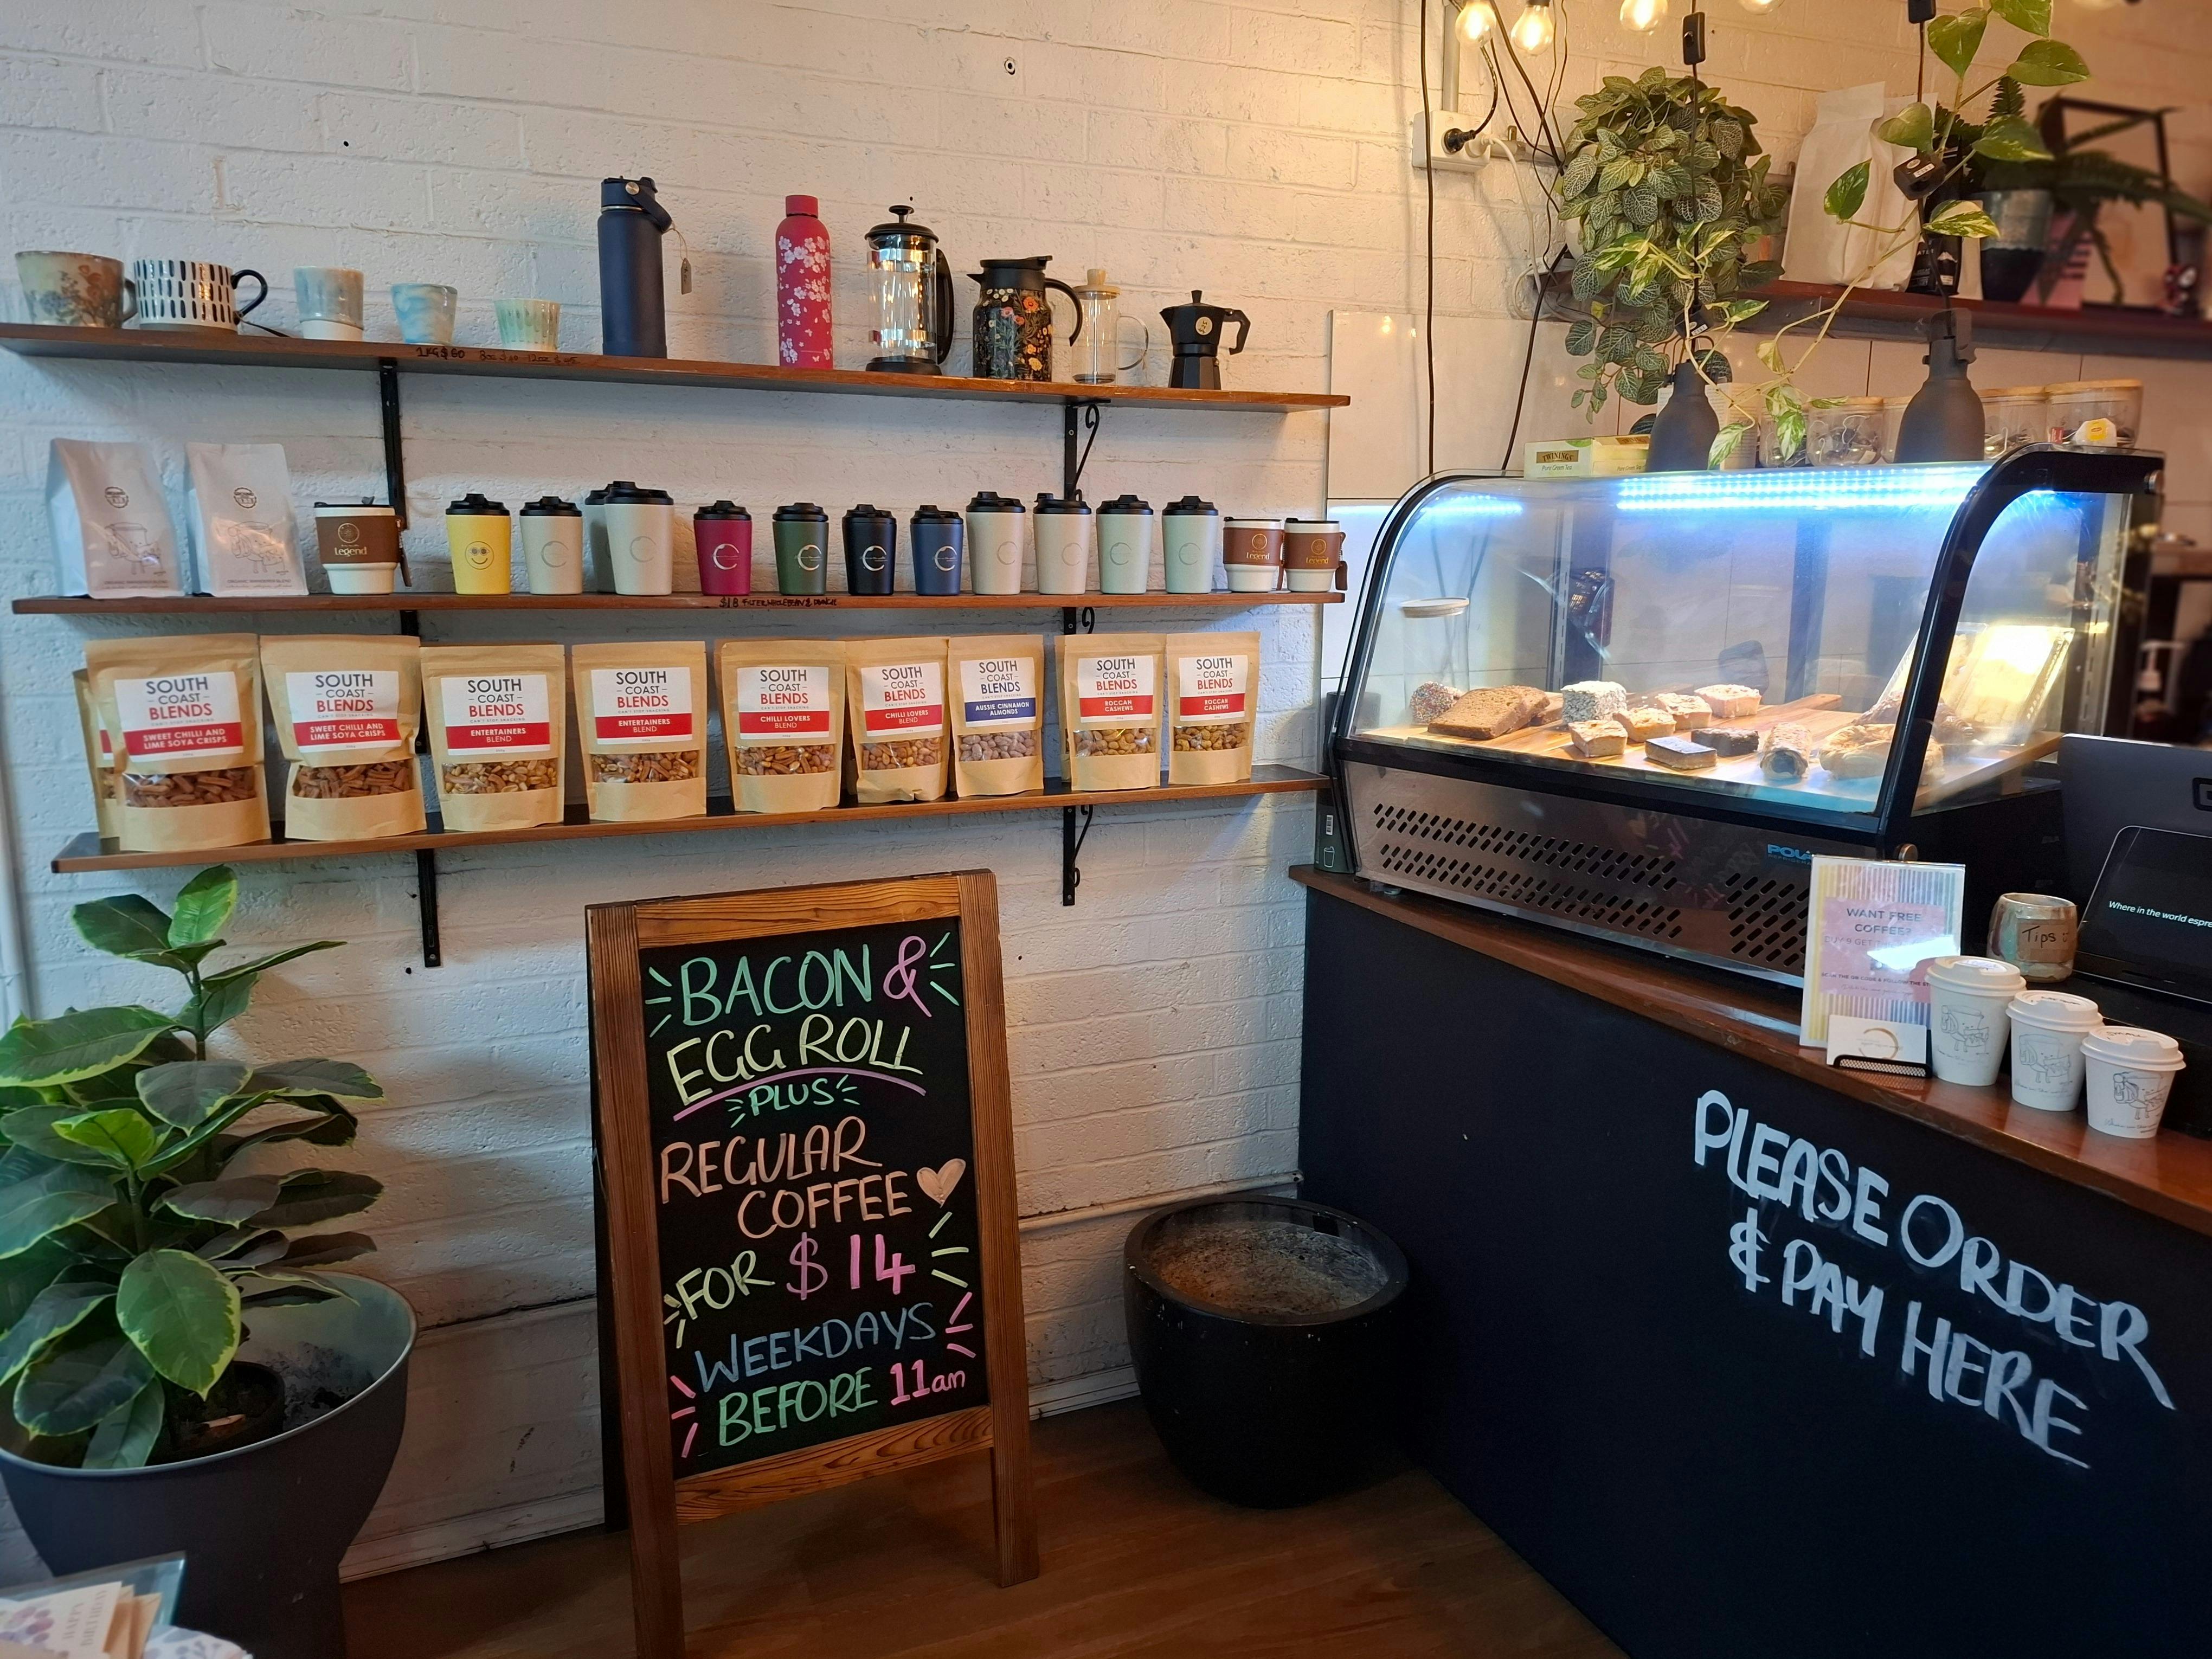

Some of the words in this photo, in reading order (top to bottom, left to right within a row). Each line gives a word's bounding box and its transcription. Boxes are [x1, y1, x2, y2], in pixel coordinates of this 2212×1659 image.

[1542, 452, 1573, 461] TWININGS
[335, 546, 367, 557] Legend
[1246, 552, 1270, 561] Legend
[979, 660, 1017, 673] SOUTH
[1097, 658, 1135, 671] SOUTH
[1197, 658, 1232, 670] SOUTH
[616, 671, 666, 685] SOUTH
[760, 670, 807, 682] SOUTH
[882, 666, 922, 680] SOUTH
[987, 673, 1013, 682] COAST
[1103, 671, 1130, 679] COAST
[146, 677, 208, 694] SOUTH
[316, 674, 373, 687] SOUTH
[468, 679, 522, 693] SOUTH
[891, 680, 917, 689] COAST
[1096, 679, 1137, 691] BLENDS
[1198, 678, 1233, 690] BLENDS
[326, 689, 365, 698] COAST
[625, 686, 659, 695] COAST
[768, 684, 800, 692] COAST
[981, 681, 1020, 694] BLENDS
[158, 693, 200, 704] COAST
[478, 694, 514, 703] COAST
[618, 695, 668, 708] BLENDS
[761, 693, 808, 704] BLENDS
[885, 689, 925, 702] BLENDS
[149, 703, 212, 720] BLENDS
[317, 699, 374, 712] BLENDS
[470, 704, 524, 717] BLENDS
[619, 718, 670, 726] ENTERTAINERS
[143, 732, 171, 741] SWEET
[175, 730, 202, 738] CHILLI
[471, 728, 526, 736] ENTERTAINERS
[144, 741, 165, 749] LIME
[168, 739, 194, 747] SOYA
[197, 736, 227, 744] CRISPS
[1847, 909, 1885, 919] WANT
[1889, 912, 1921, 921] FREE
[2109, 901, 2136, 912] Where
[2146, 908, 2160, 917] the
[2162, 912, 2188, 922] world
[1855, 924, 1911, 935] COFFEE?
[2022, 926, 2056, 948] Tips
[680, 944, 872, 1026] BACON
[883, 935, 932, 1017] &
[667, 1024, 787, 1106] EGG
[800, 1014, 923, 1075] ROLL
[749, 1078, 834, 1116] PLUS
[661, 1116, 883, 1204] REGULAR
[738, 1171, 912, 1238] COFFEE
[1694, 1090, 1889, 1246] PLEASE
[1901, 1194, 2176, 1410] ORDER
[676, 1250, 775, 1320] FOR
[1729, 1207, 1771, 1293] &
[1782, 1239, 1884, 1358] PAY
[1901, 1300, 2091, 1469] HERE
[695, 1302, 936, 1392] WEEKDAYS
[719, 1366, 878, 1446] BEFORE
[890, 1360, 966, 1405] 11am
